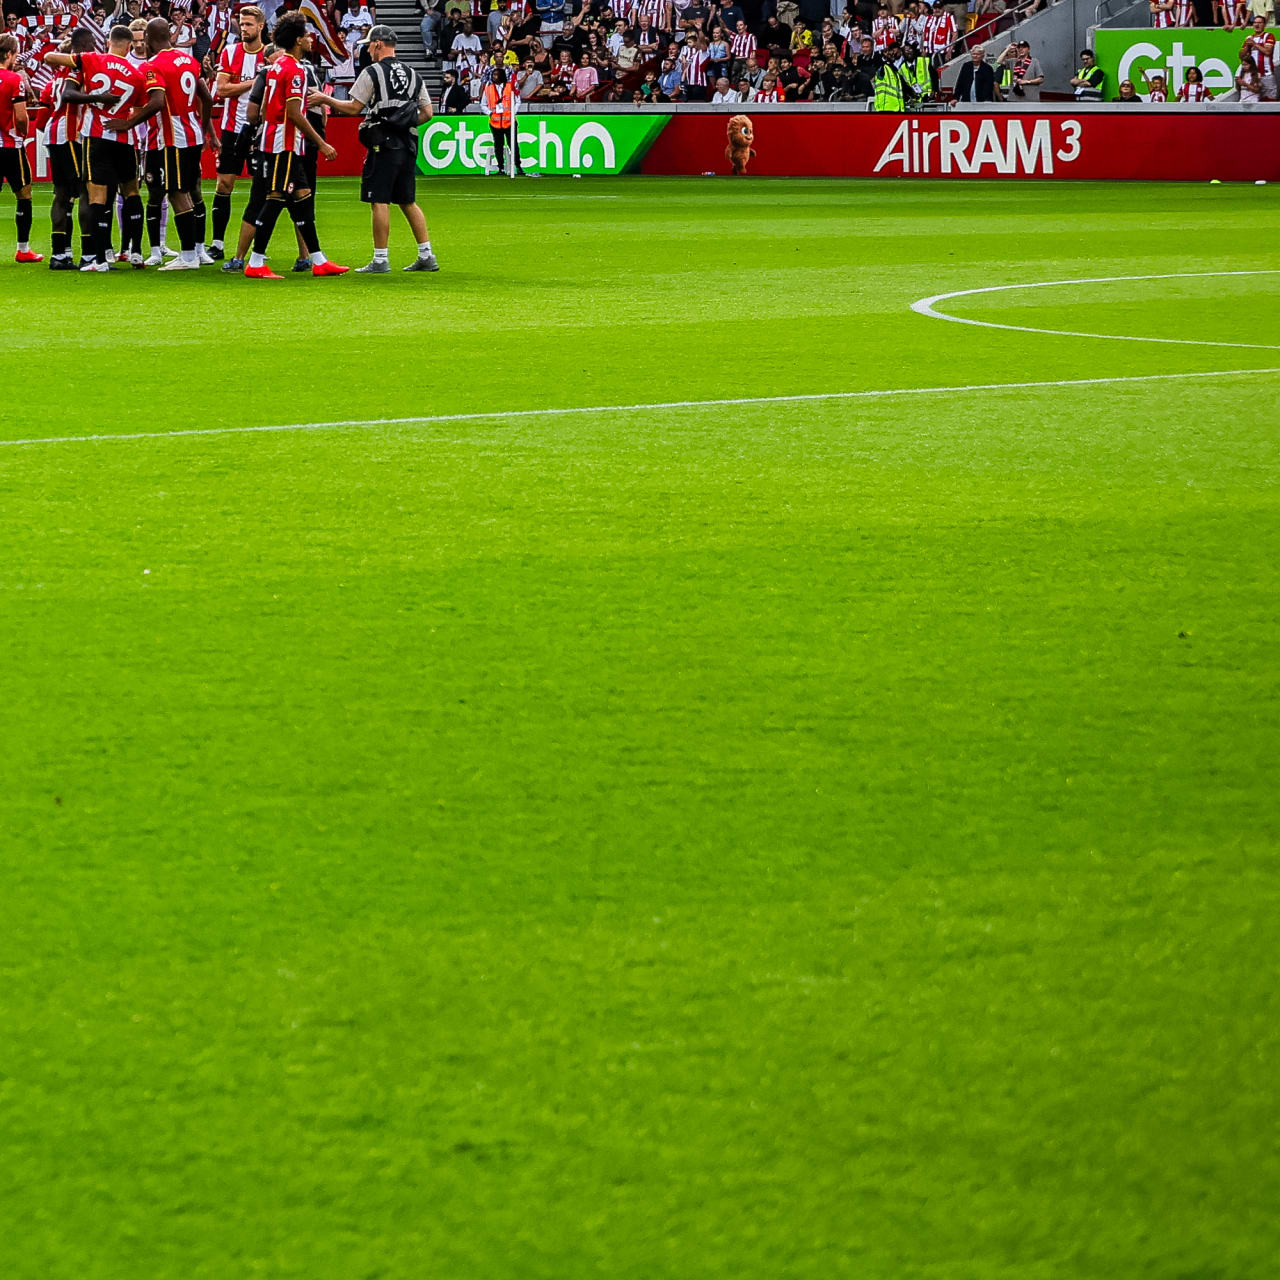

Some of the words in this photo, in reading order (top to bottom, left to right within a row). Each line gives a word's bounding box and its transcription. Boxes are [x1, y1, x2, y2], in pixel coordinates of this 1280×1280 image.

[106, 61, 132, 77] JANELT
[180, 71, 197, 107] 9
[1118, 42, 1243, 103] Gte
[86, 73, 135, 115] 27
[422, 121, 564, 169] Gtech
